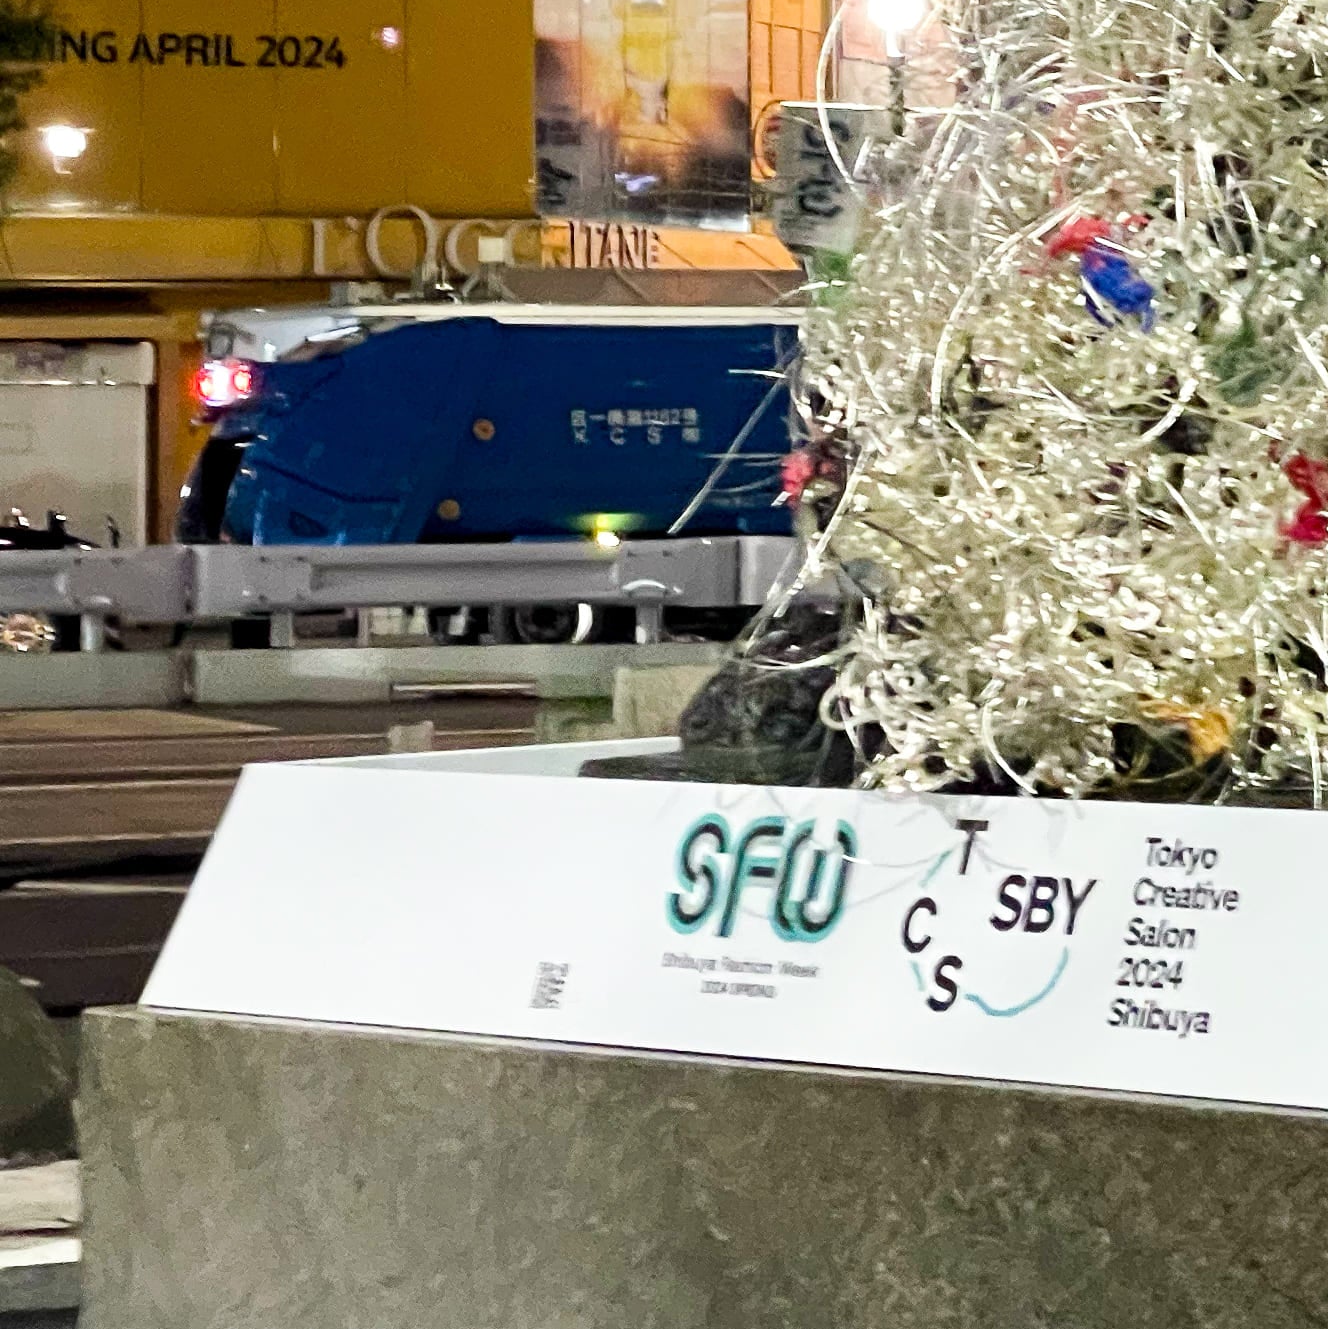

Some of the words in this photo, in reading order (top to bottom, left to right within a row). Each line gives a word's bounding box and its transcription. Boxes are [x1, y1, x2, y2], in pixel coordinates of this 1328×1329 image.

[128, 31, 246, 68] APRIL
[255, 35, 347, 69] 2024
[1143, 836, 1219, 875] Tokyo
[989, 874, 1099, 935] SBY
[1131, 876, 1241, 913] Creative
[1123, 916, 1196, 950] Salon
[1115, 957, 1185, 990] 2024
[1106, 997, 1211, 1039] Shibuya
